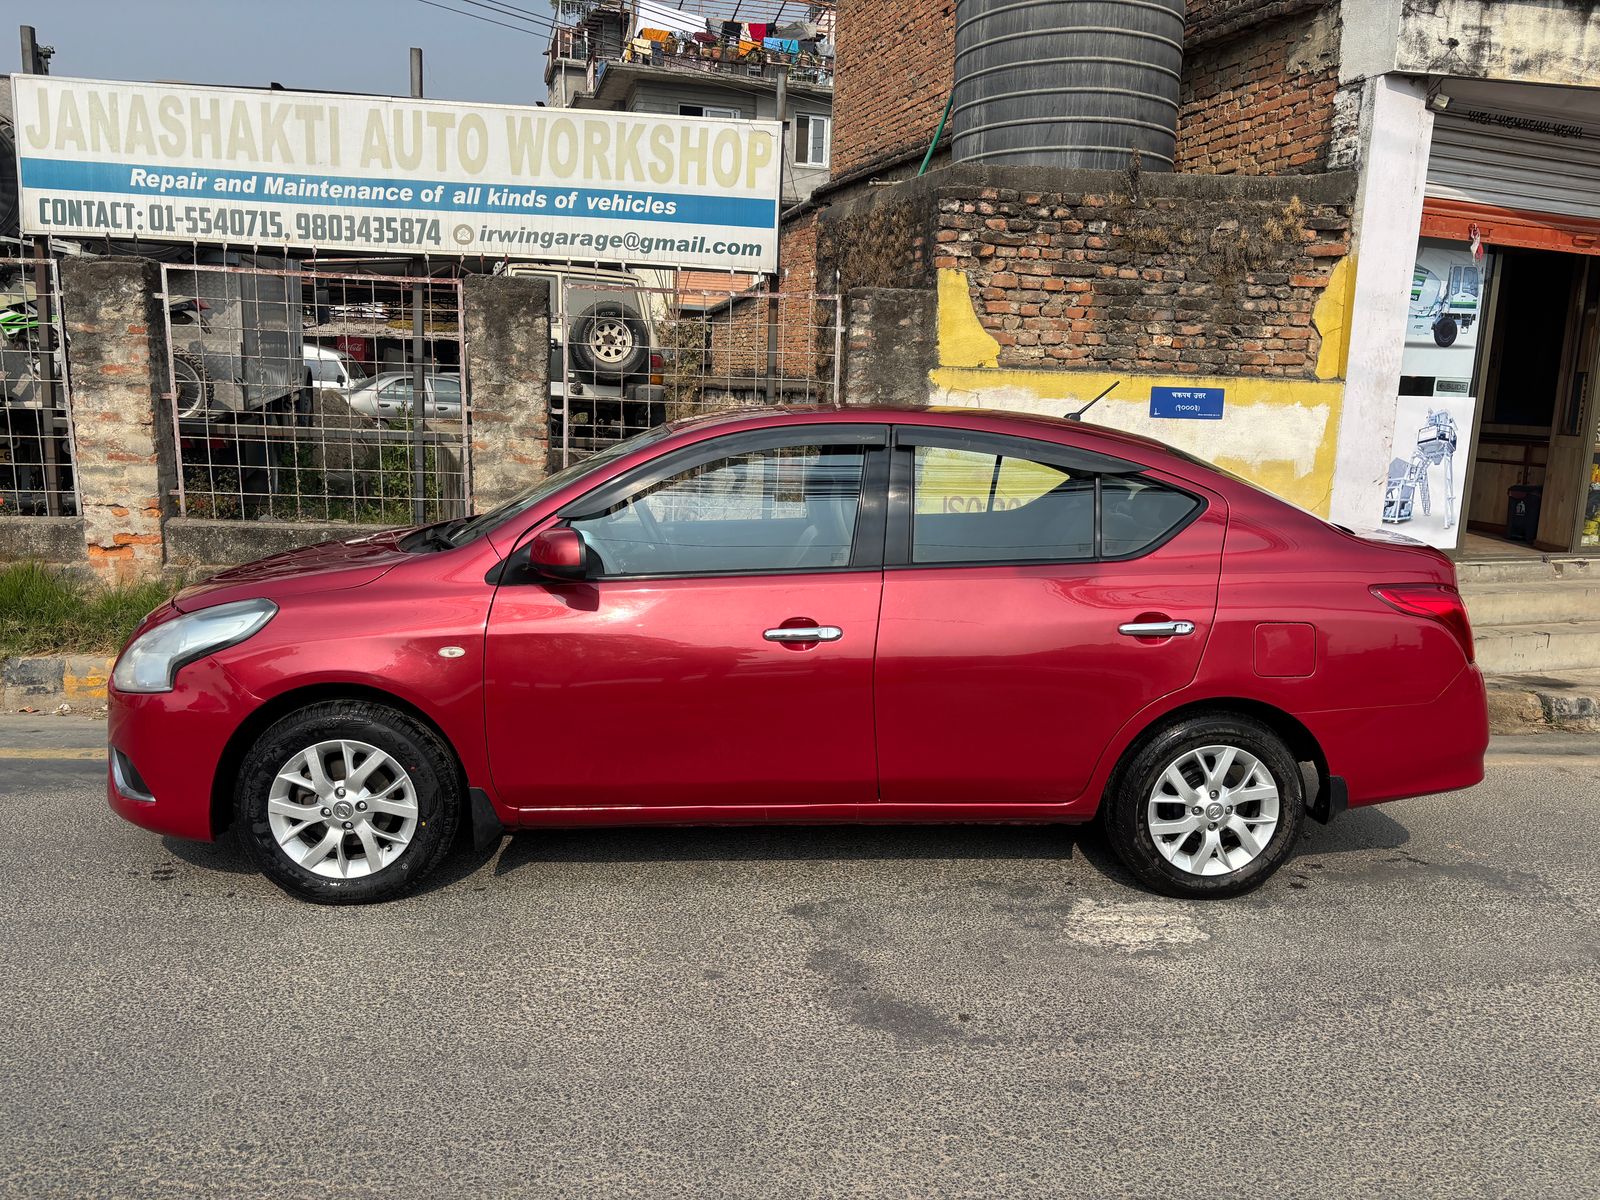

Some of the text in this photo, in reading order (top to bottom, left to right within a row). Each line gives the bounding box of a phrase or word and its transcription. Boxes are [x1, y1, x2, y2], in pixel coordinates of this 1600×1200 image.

[25, 87, 773, 188] JANASHAKTI AUTO WORKSHOP
[130, 168, 677, 215] Repair and Maintenance of all kinds of vehicles
[39, 197, 762, 258] CONTACT: 01-5540715, 9803435874 irwingarage@gmail.com
